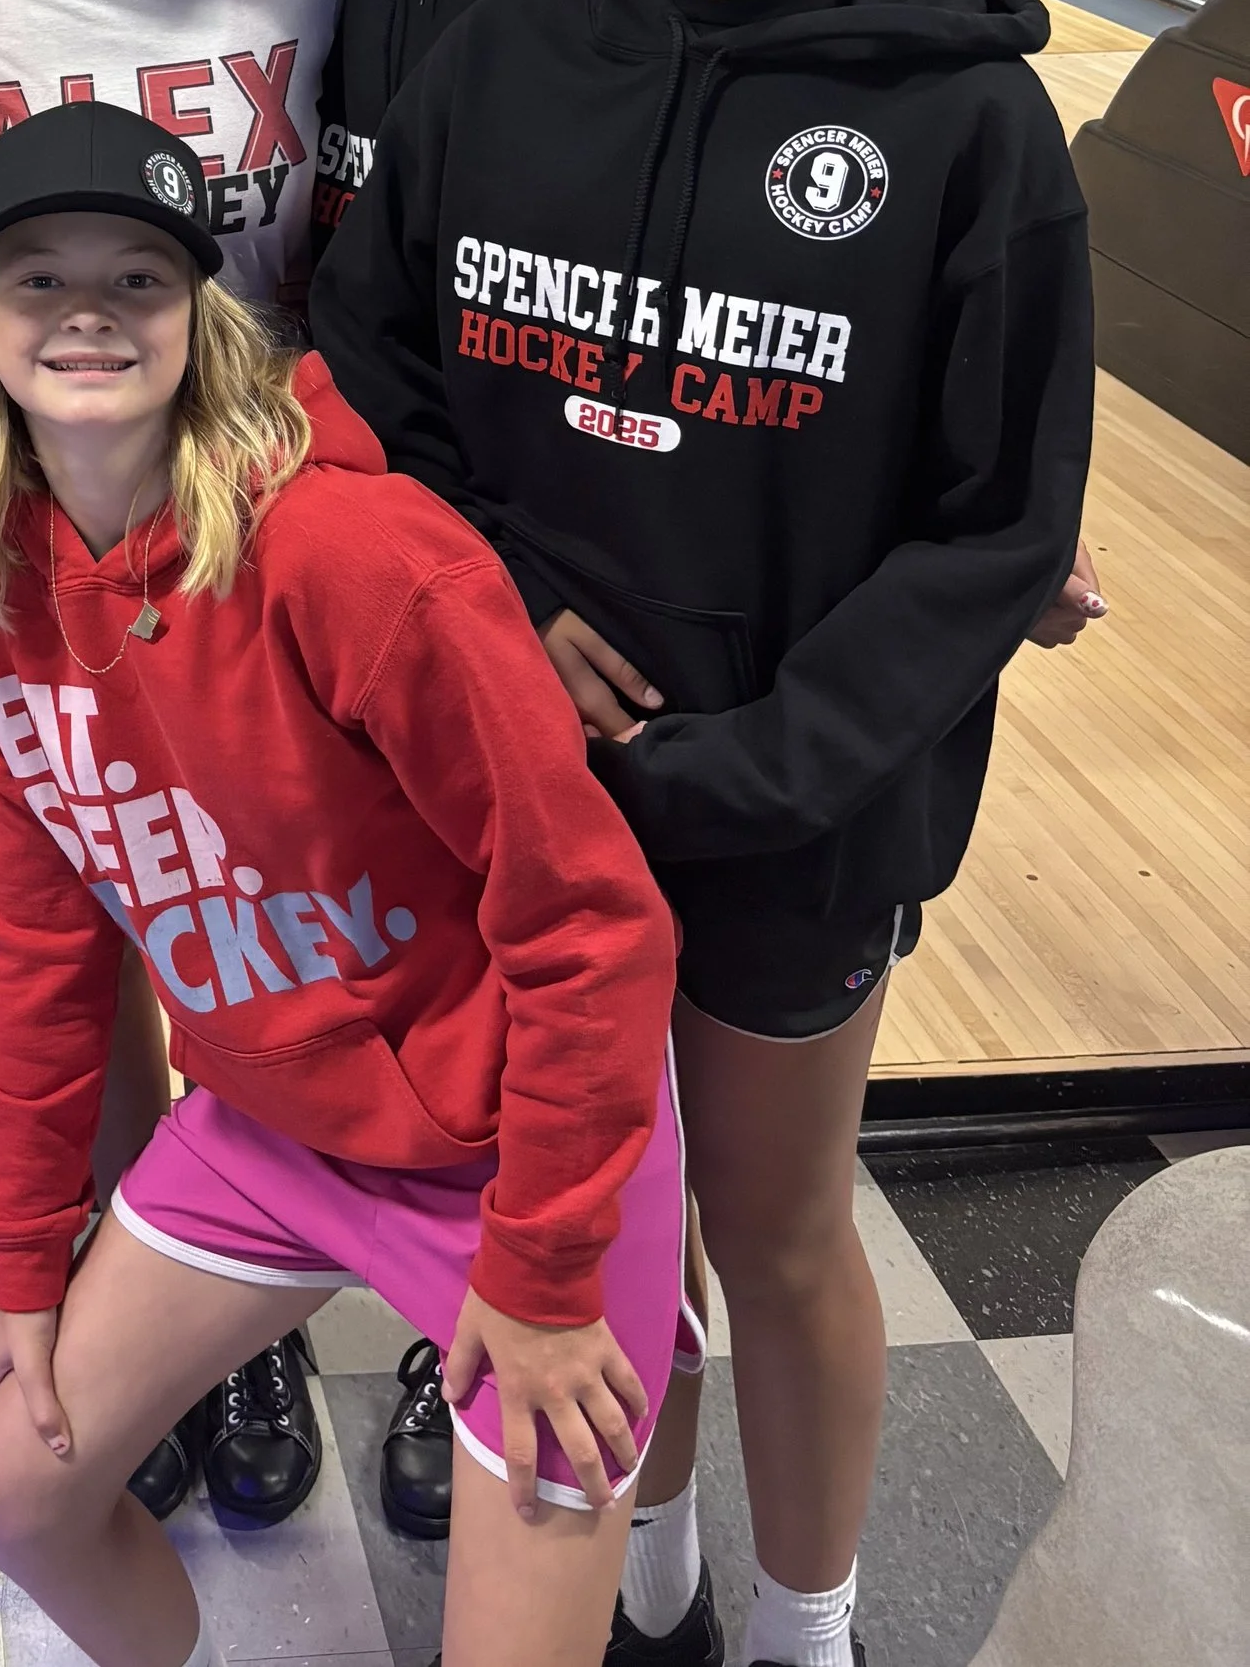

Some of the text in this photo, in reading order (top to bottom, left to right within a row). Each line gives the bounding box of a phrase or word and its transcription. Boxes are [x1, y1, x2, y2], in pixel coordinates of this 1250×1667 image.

[776, 129, 849, 168] SPENCER
[848, 135, 885, 180] MEIER
[162, 166, 181, 202] 9
[804, 151, 850, 213] 9
[770, 183, 826, 234] HOCKEY
[828, 200, 873, 234] CAMP
[676, 286, 852, 384] MEIER
[669, 362, 824, 430] CAMP
[578, 402, 662, 449] 2025
